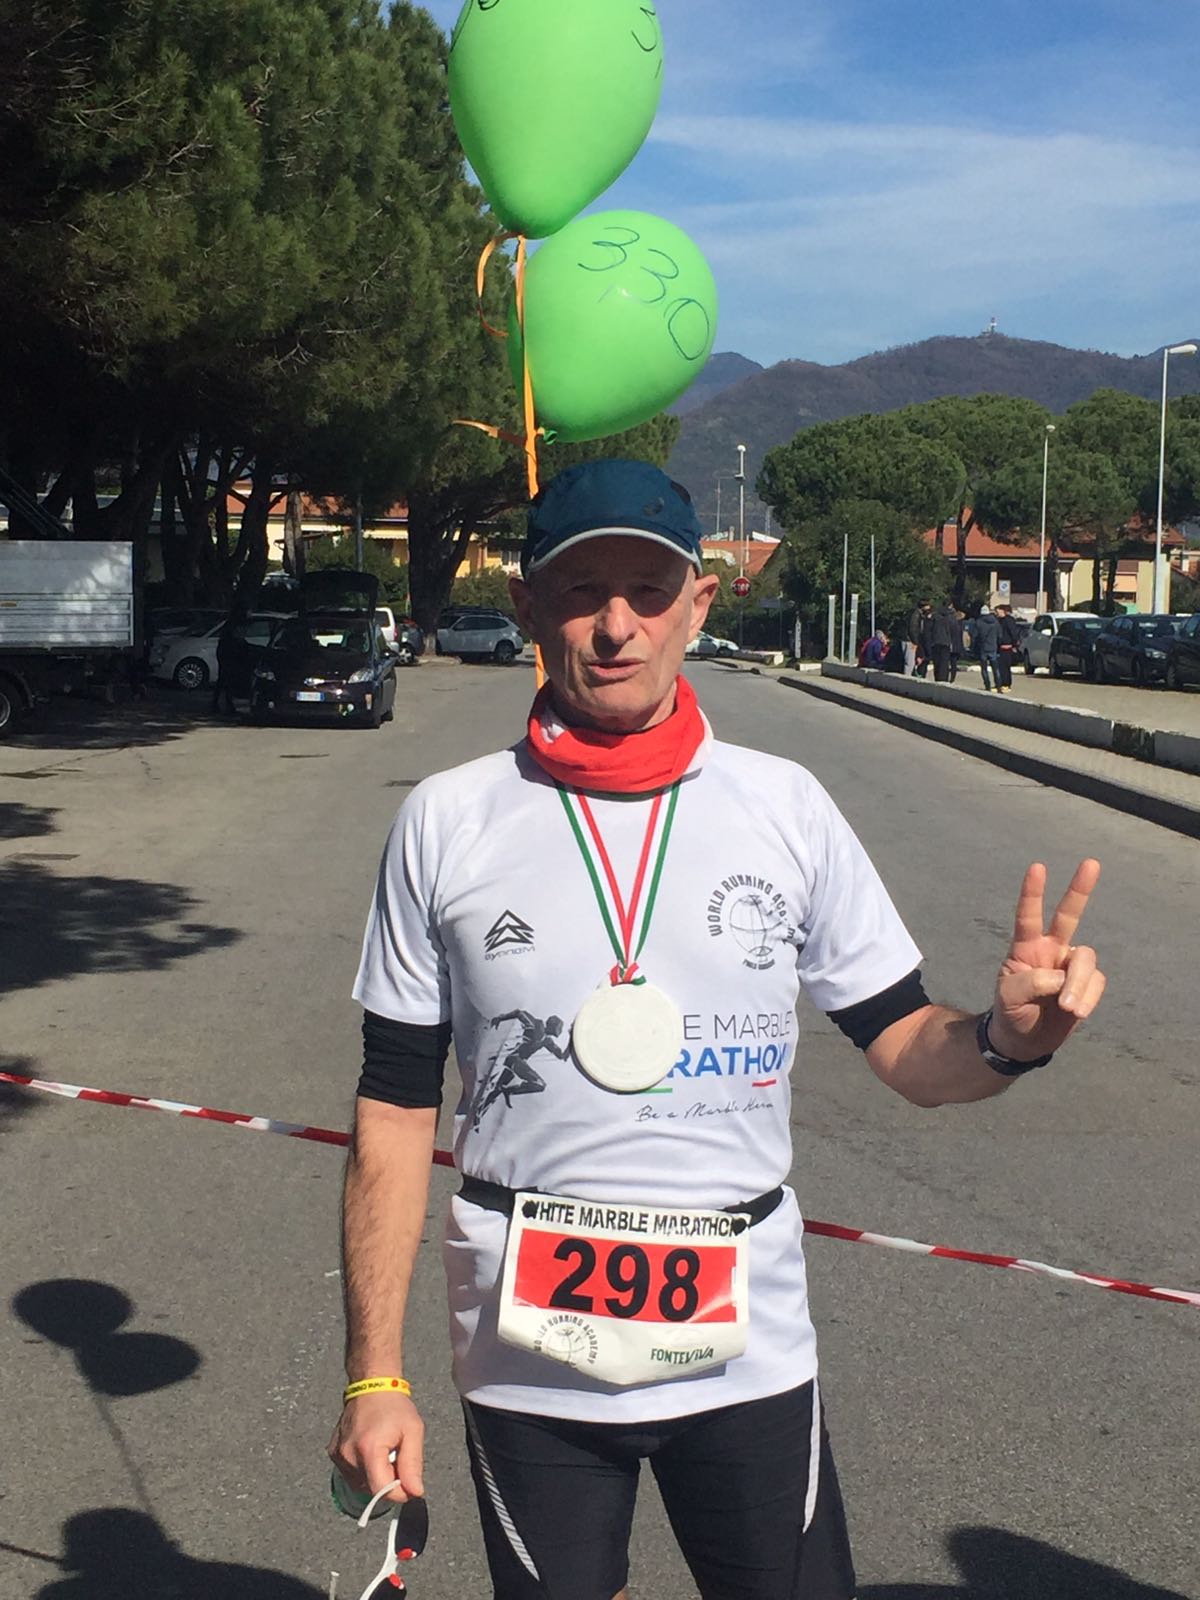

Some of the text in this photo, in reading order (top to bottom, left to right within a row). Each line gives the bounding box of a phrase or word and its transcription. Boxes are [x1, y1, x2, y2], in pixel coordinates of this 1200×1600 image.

[707, 890, 725, 937] WORLD
[721, 874, 773, 895] RUNNING
[714, 1010, 792, 1040] MARBLE
[635, 1104, 661, 1122] Be
[526, 1200, 575, 1225] HITE
[578, 1206, 649, 1233] MARBLE
[549, 1237, 700, 1322] 298
[547, 1314, 584, 1327] RUNNING
[582, 1324, 599, 1365] ACADEMY
